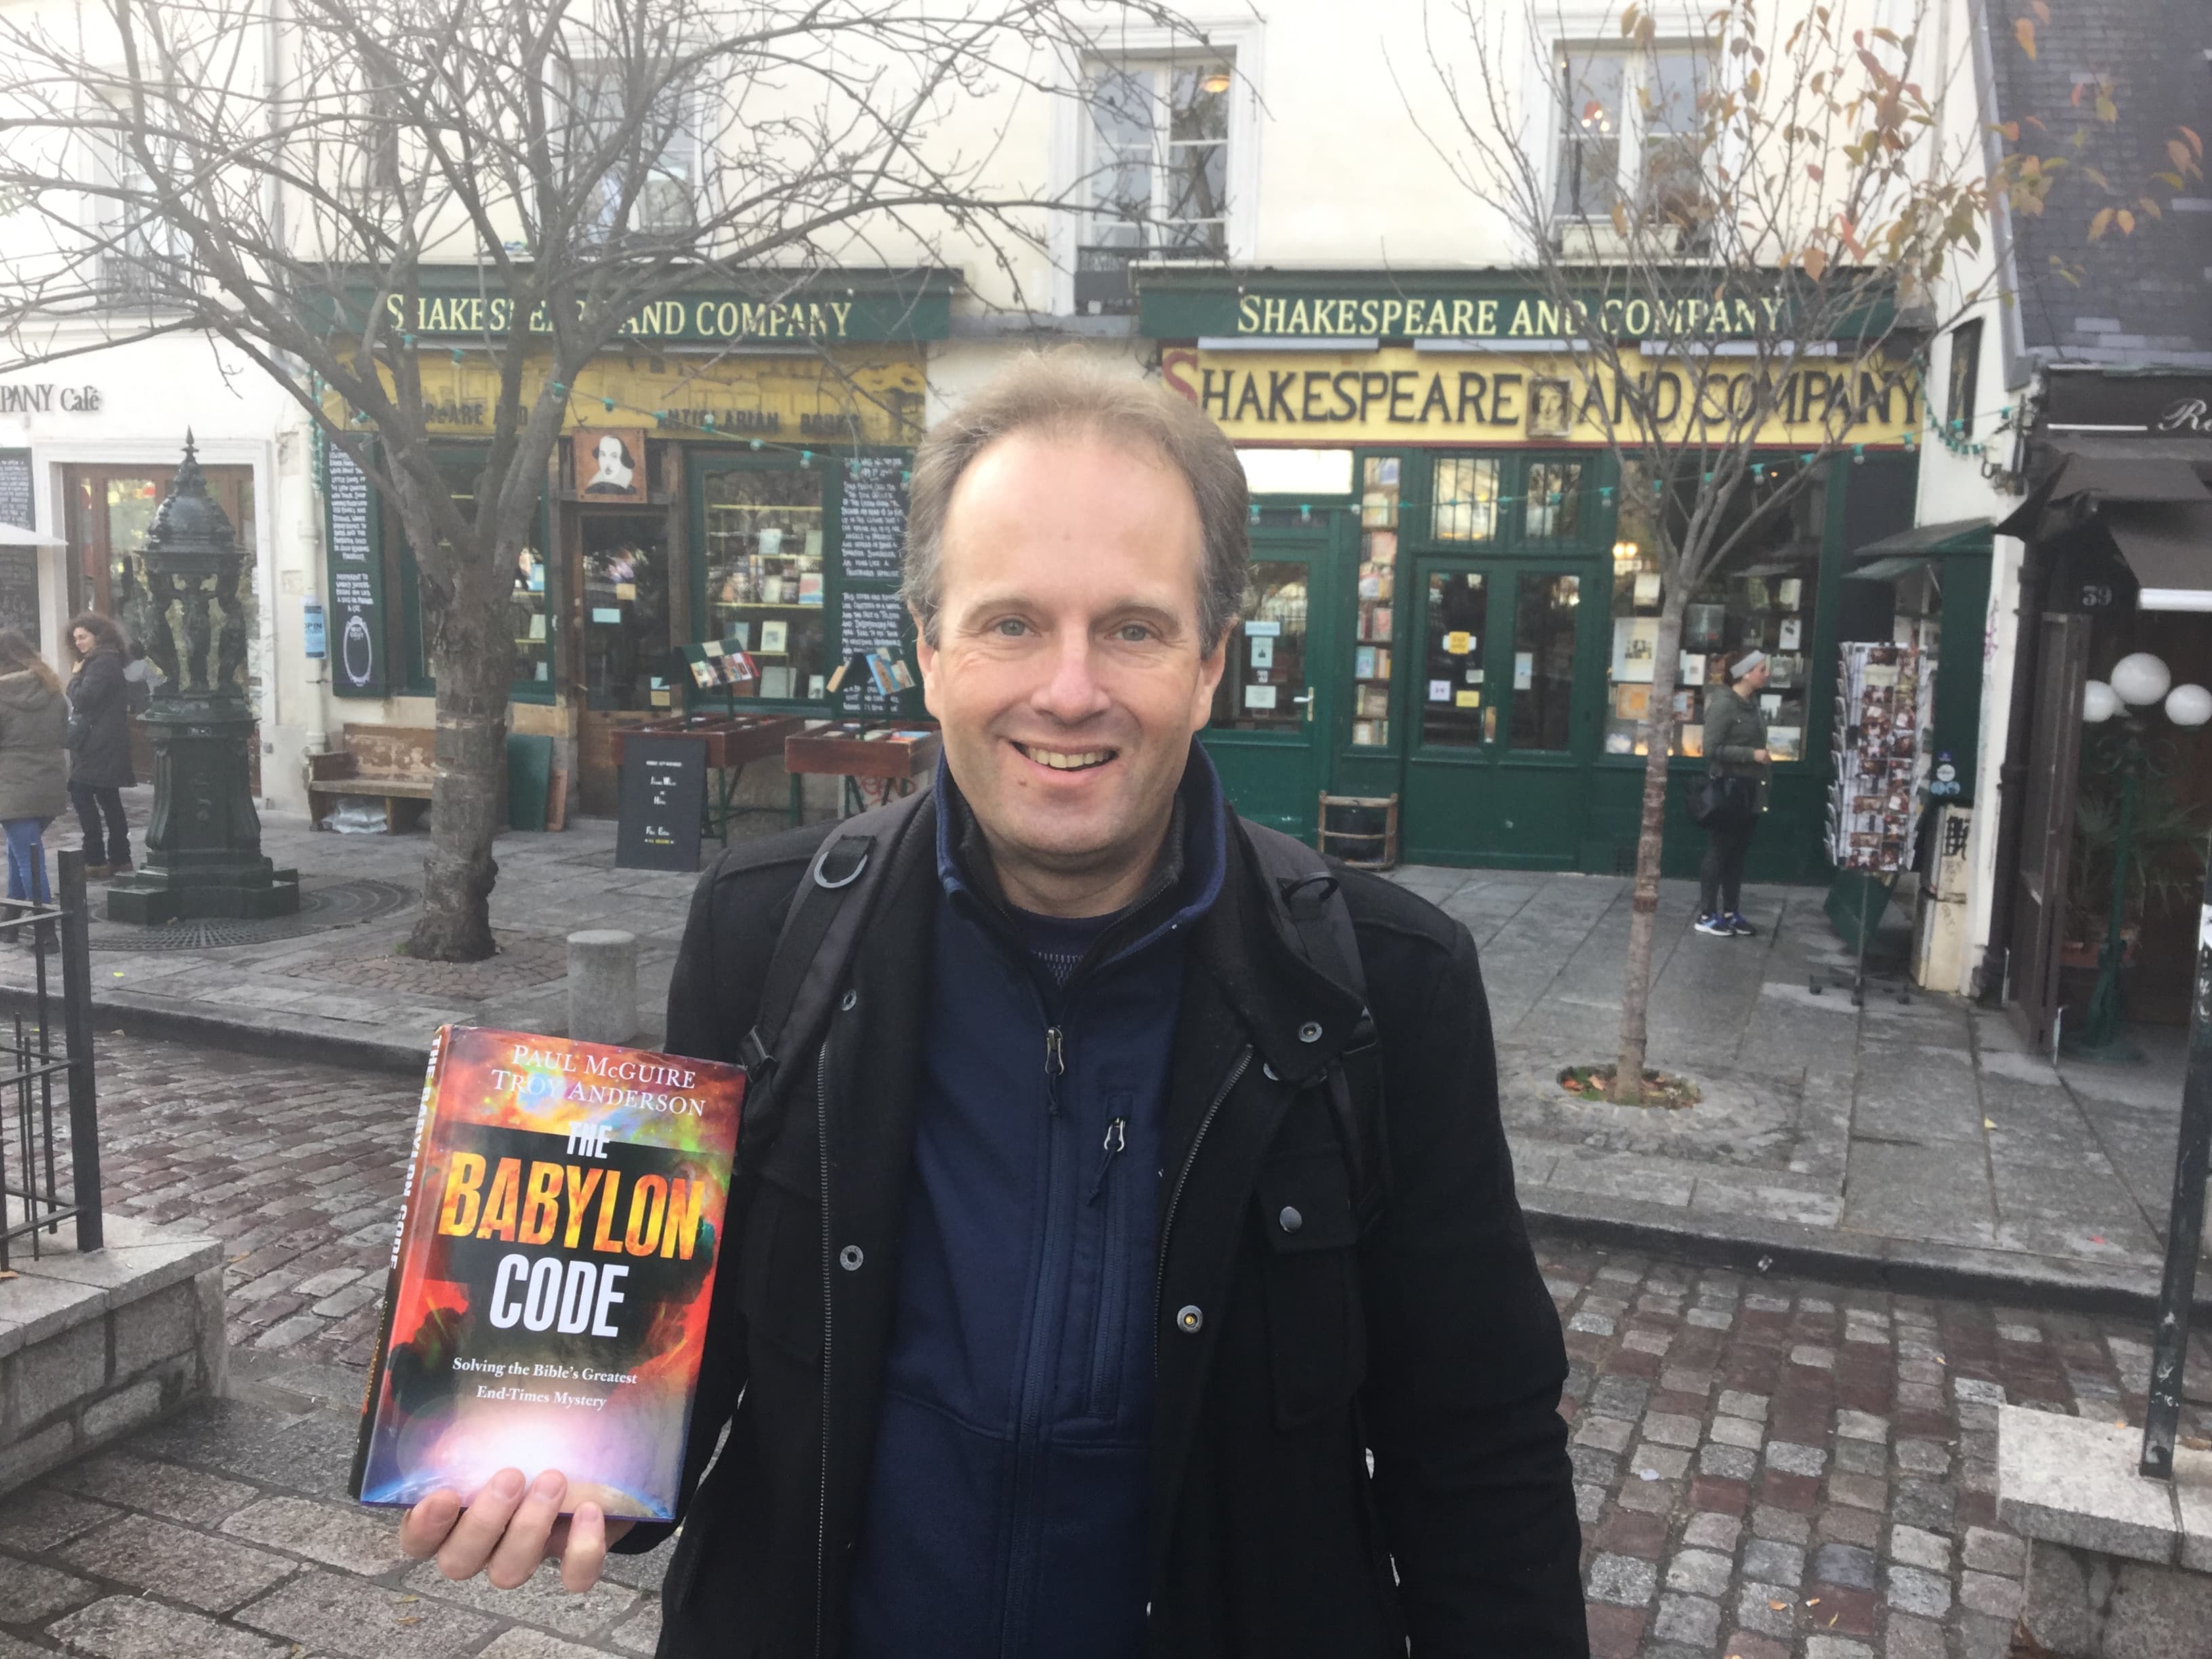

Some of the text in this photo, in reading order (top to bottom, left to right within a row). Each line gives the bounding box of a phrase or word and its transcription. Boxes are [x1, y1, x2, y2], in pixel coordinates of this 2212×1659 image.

[696, 302, 852, 337] COMPANY
[1237, 294, 1784, 335] SHAKESPEARE AND COMPANY
[60, 385, 100, 412] Café
[1162, 350, 1921, 426] SHAKESPEARE AND COMPANY
[425, 1035, 442, 1080] THE
[512, 1044, 696, 1090] PAUL McGUIRE
[491, 1069, 706, 1117] TROY ANDERSON
[567, 1121, 613, 1160] THE
[438, 1151, 705, 1261] BABYLON
[390, 1204, 407, 1270] CODE
[489, 1254, 630, 1338] CODE
[452, 1357, 638, 1385] Solving the Bible's Greatest
[476, 1385, 607, 1411] End-Times Mystery
